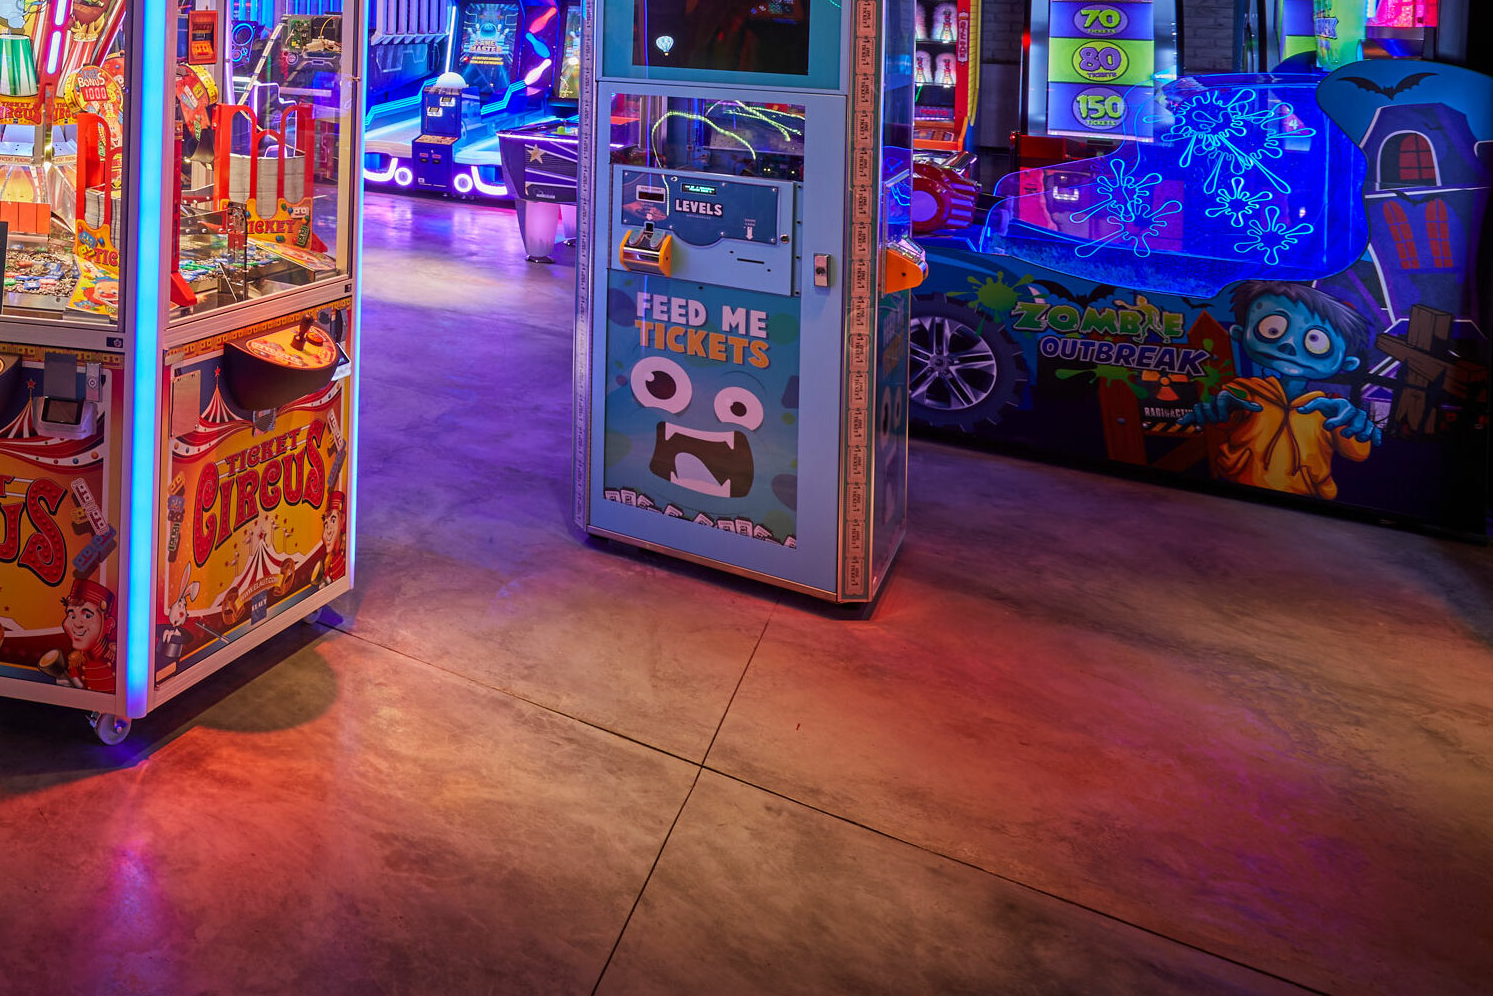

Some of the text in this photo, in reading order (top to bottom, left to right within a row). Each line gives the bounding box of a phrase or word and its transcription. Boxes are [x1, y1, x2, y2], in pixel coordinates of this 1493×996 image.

[1080, 9, 1121, 29] 70
[1079, 47, 1122, 71] 80
[78, 72, 105, 87] BONUS
[85, 88, 107, 100] 1000
[1076, 94, 1124, 120] 150
[675, 199, 723, 217] LEVELS
[636, 291, 768, 339] FEED ME
[634, 319, 770, 369] TICKETS
[1040, 336, 1211, 376] OUTBREAK
[225, 427, 302, 478] TICKET
[193, 418, 327, 568] CIRCUS
